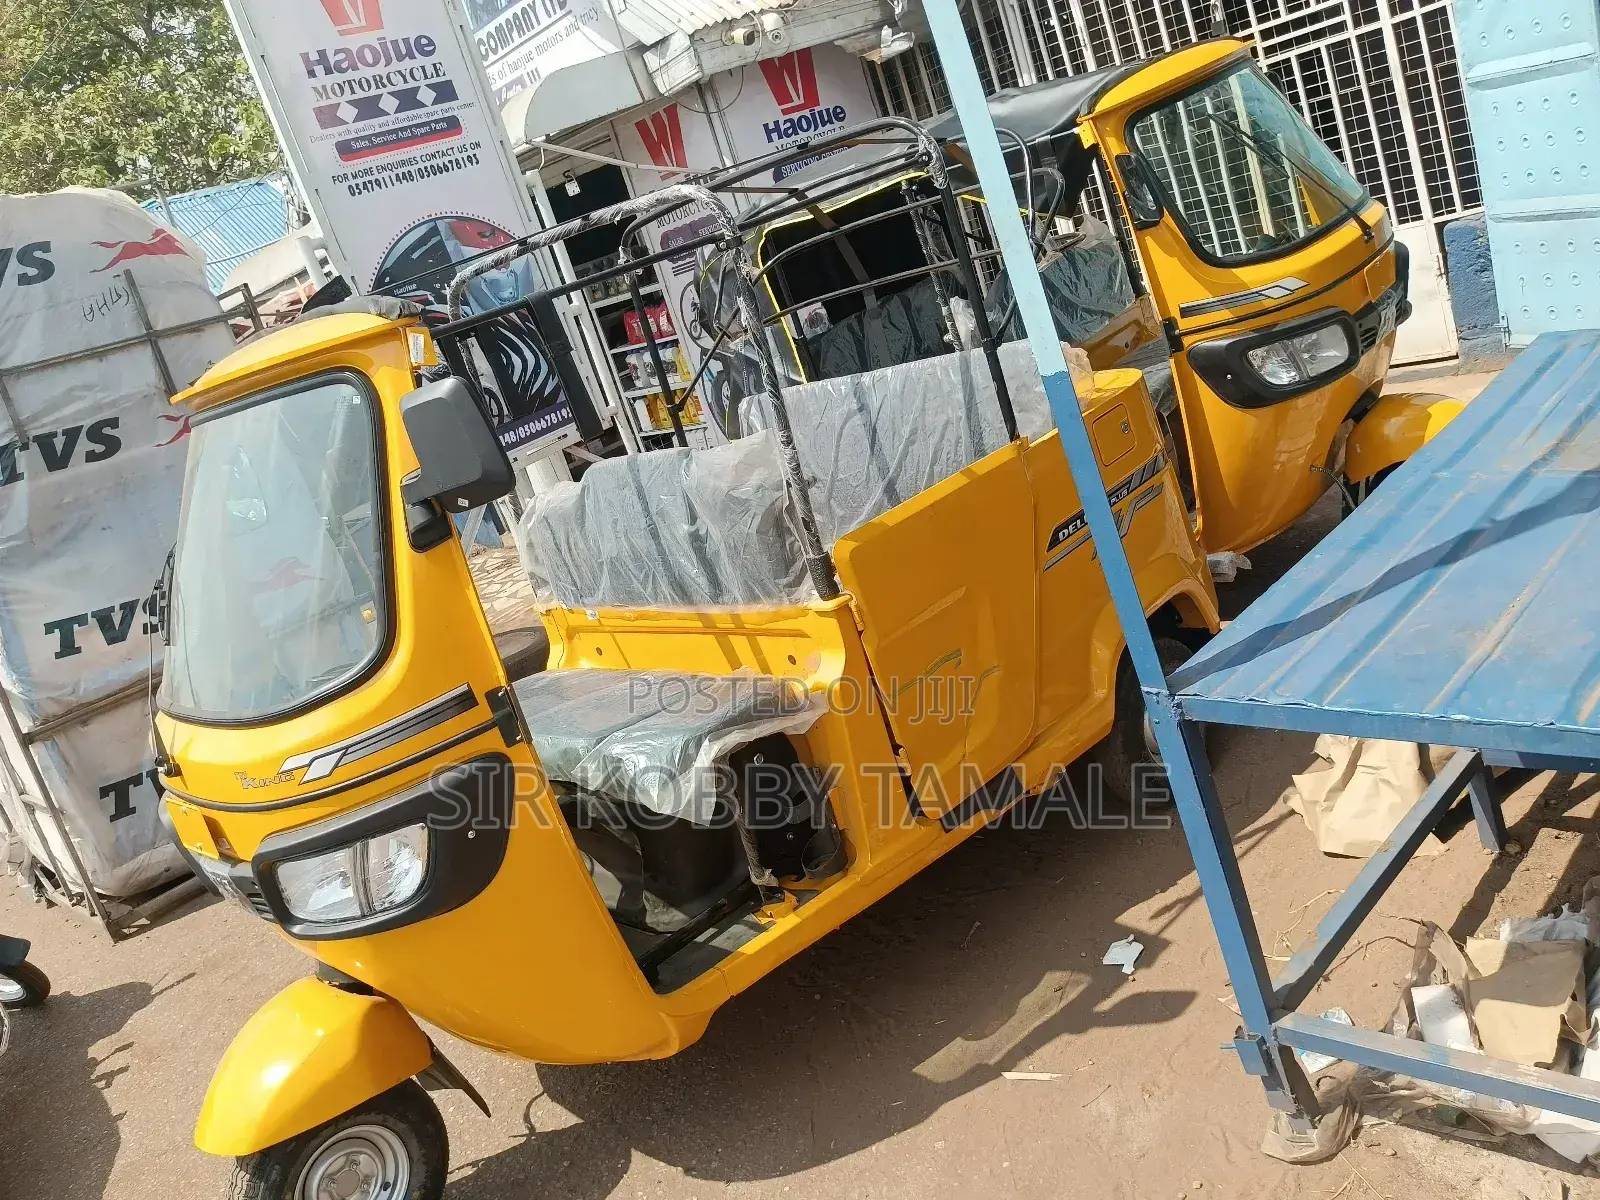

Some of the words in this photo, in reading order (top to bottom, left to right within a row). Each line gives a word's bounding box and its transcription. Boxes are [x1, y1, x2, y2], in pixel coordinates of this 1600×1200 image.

[476, 0, 541, 62] COMPANY
[497, 62, 508, 80] of
[508, 51, 535, 75] haojue
[535, 31, 564, 57] motors
[564, 15, 580, 37] and
[580, 7, 599, 26] tricy
[299, 35, 437, 79] Haojue
[311, 62, 447, 102] MOTORCYCLE
[309, 133, 336, 144] Dealers
[338, 128, 352, 137] with
[354, 123, 376, 134] quality
[378, 119, 390, 128] and
[391, 112, 423, 126] affordable
[424, 109, 440, 120] spare
[441, 105, 456, 115] parts
[372, 132, 397, 144] Service
[398, 128, 412, 138] And
[412, 125, 430, 136] Spare
[431, 121, 447, 131] Parts
[762, 105, 847, 143] Haojue
[332, 172, 350, 185] FOR
[351, 166, 375, 181] MORE
[376, 156, 419, 176] ENQUIRIES
[420, 147, 455, 163] CONTACT
[456, 143, 469, 154] US
[469, 140, 482, 151] ON
[656, 198, 708, 228] MOTORCYC
[1110, 488, 1128, 506] PLUS
[44, 591, 167, 660] TVS
[241, 772, 295, 789] KING
